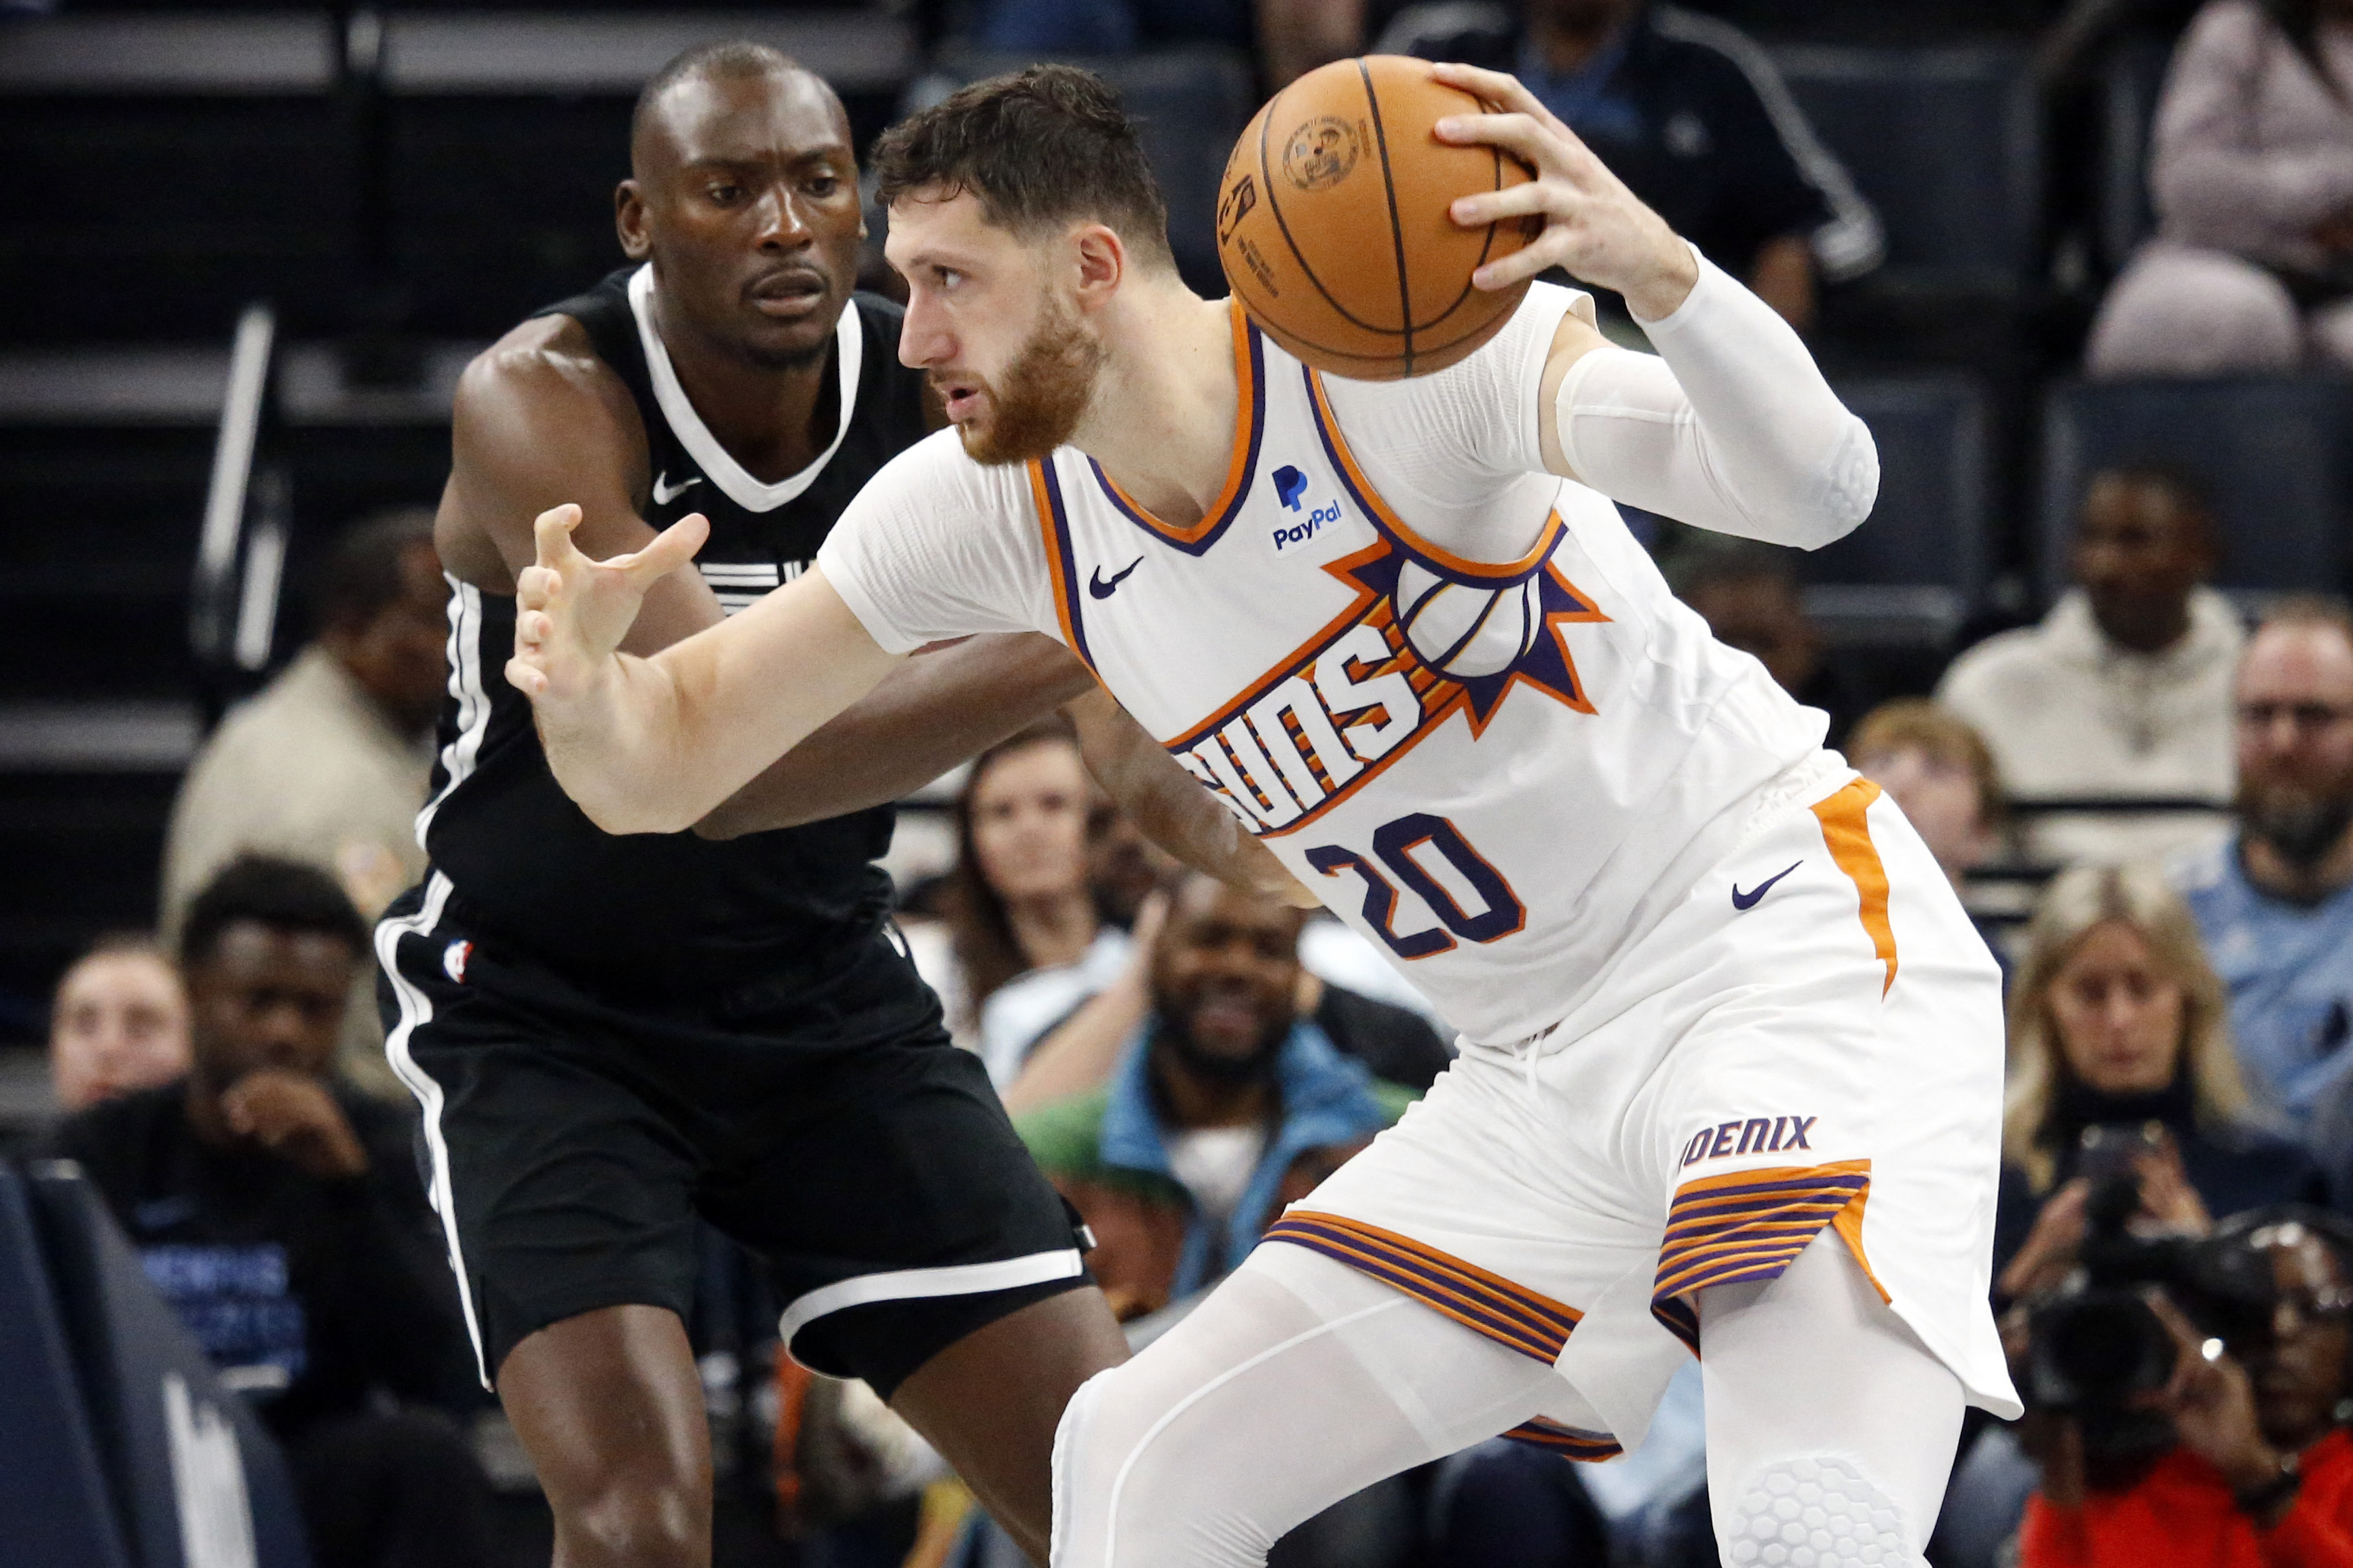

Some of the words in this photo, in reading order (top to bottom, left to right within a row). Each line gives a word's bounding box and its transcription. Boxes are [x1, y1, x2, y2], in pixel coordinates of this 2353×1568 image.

[1273, 499, 1342, 551] PayPal
[1304, 811, 1527, 961] 20
[1678, 1116, 1818, 1175] OENIX
